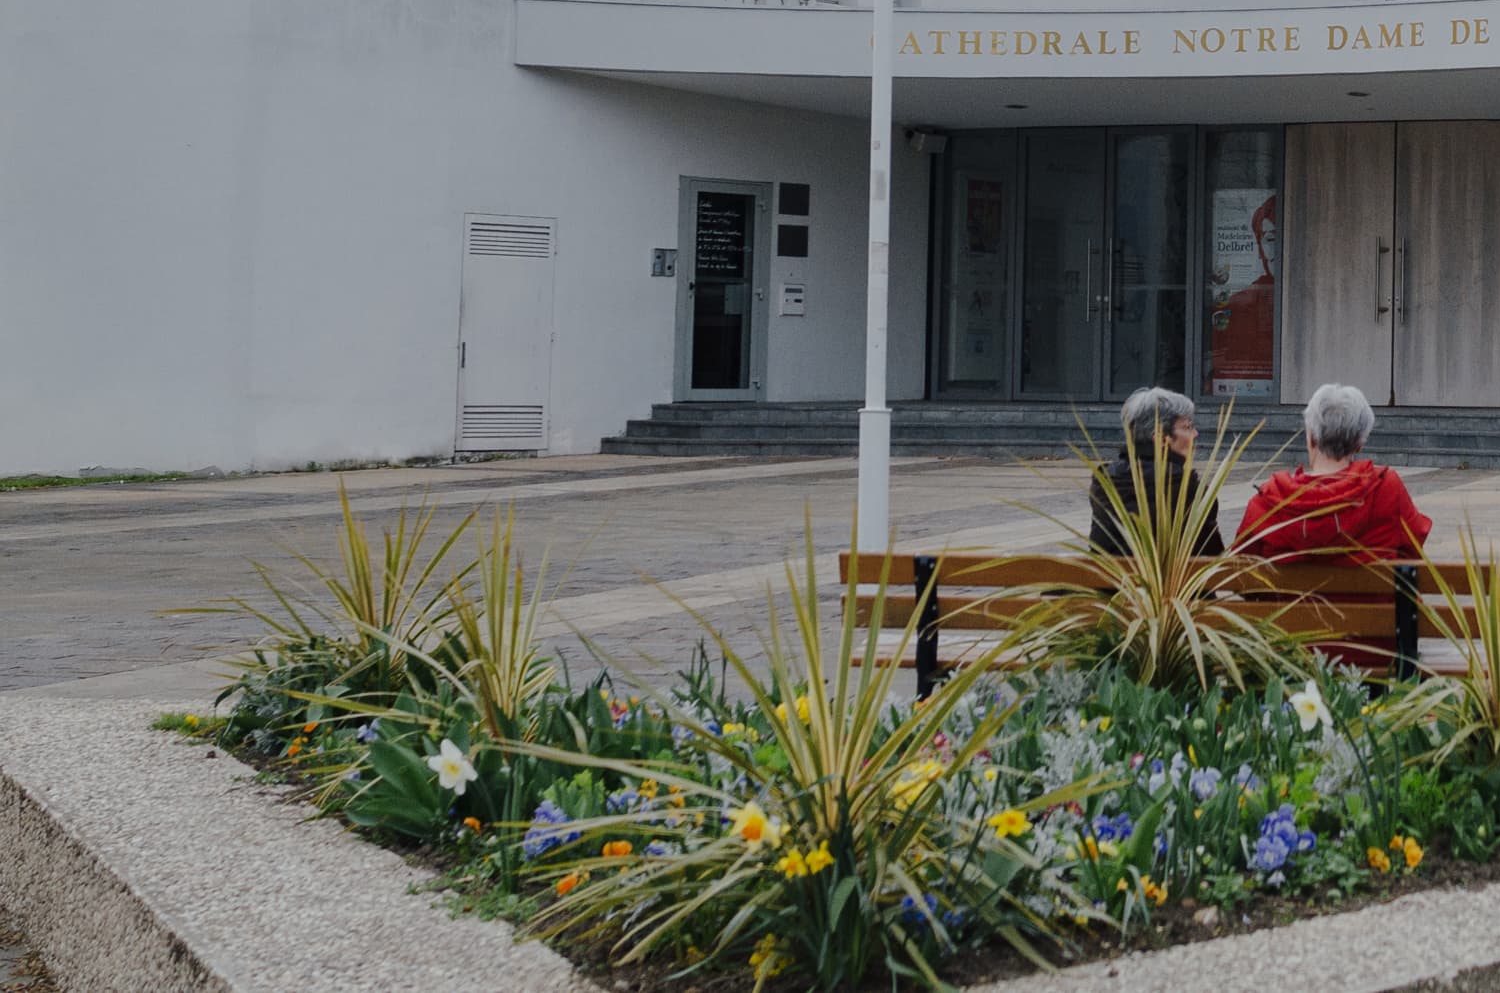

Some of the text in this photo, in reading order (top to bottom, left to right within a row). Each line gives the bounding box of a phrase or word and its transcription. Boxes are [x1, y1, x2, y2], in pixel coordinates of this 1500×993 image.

[871, 30, 1142, 56] ATHEDRALE
[1172, 26, 1301, 53] NOTRE
[1327, 22, 1425, 51] DAME
[1450, 19, 1490, 45] DE
